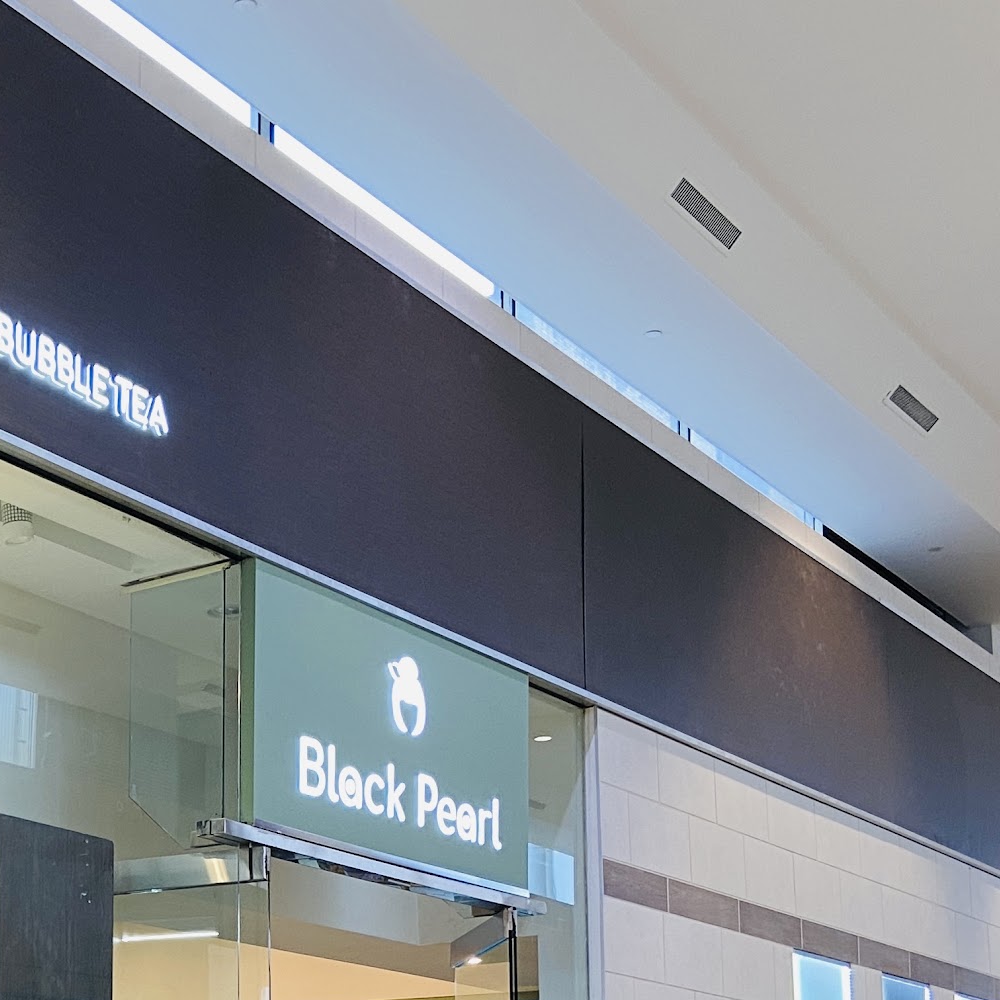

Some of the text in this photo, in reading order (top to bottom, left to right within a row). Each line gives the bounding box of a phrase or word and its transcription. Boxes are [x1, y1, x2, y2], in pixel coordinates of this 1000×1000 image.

[110, 374, 169, 436] TEA
[298, 735, 503, 851] Black Pearl
